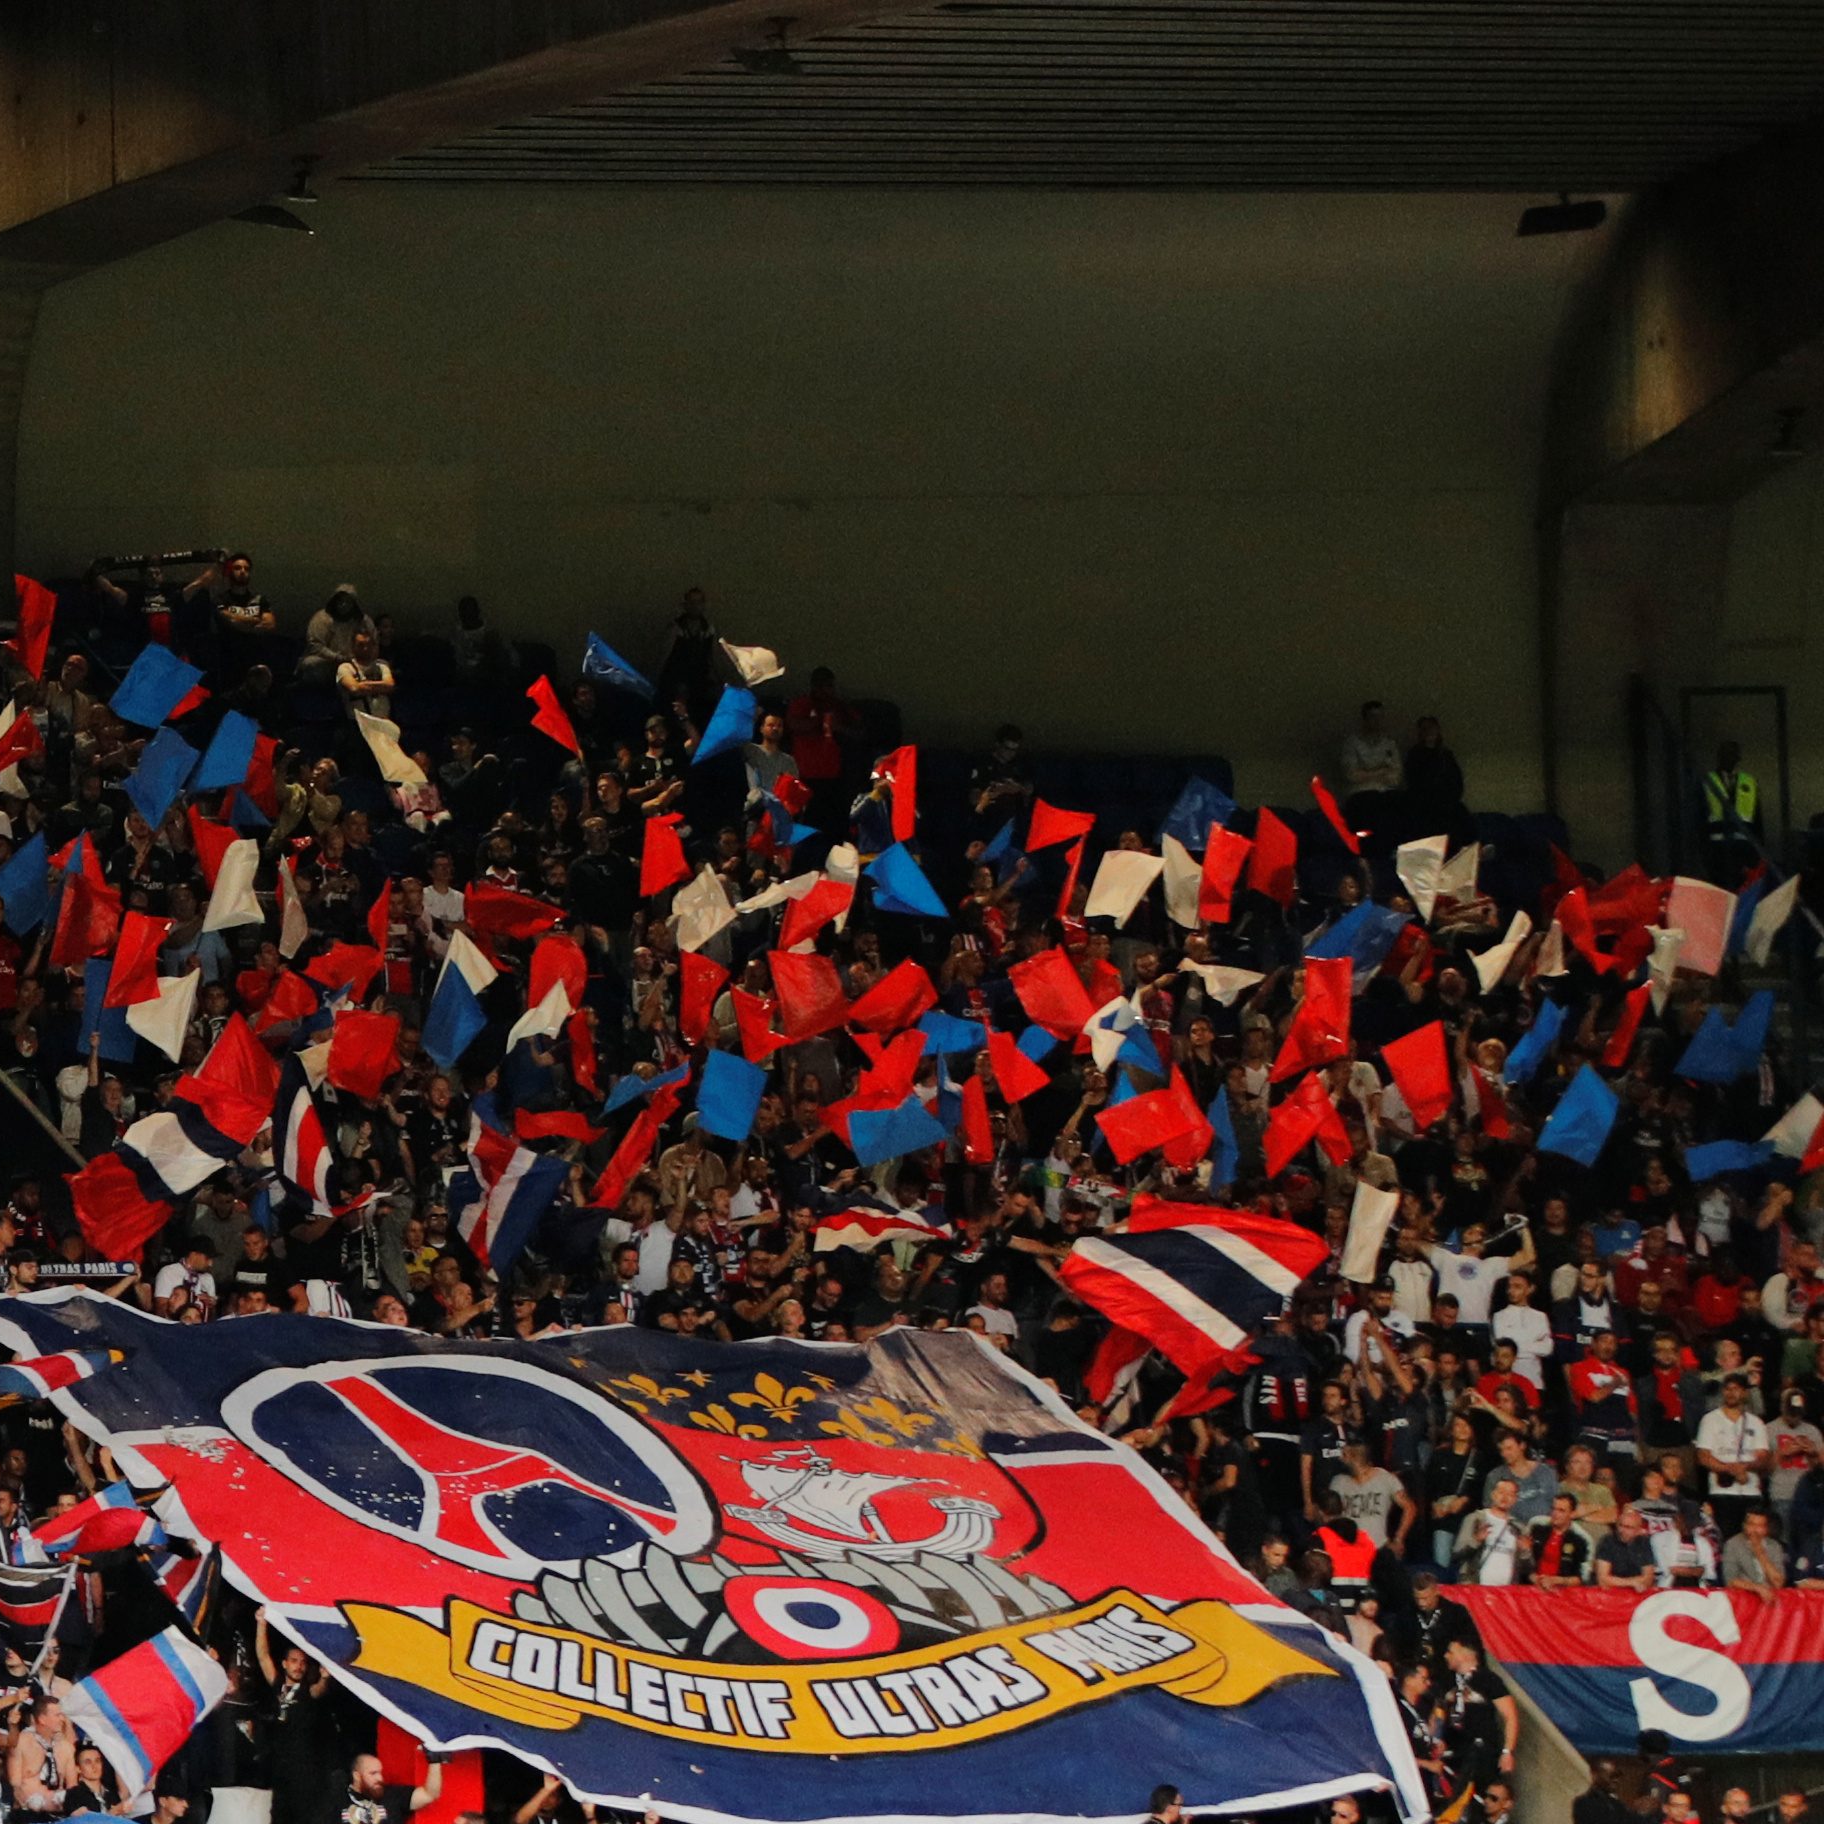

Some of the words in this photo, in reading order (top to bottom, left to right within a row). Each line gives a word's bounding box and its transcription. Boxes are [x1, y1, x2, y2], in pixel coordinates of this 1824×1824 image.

[85, 1262, 119, 1274] PARIS
[469, 1620, 793, 1740] COLLECTIF
[808, 1645, 1050, 1739] ULTRAS
[1628, 1591, 1752, 1743] S
